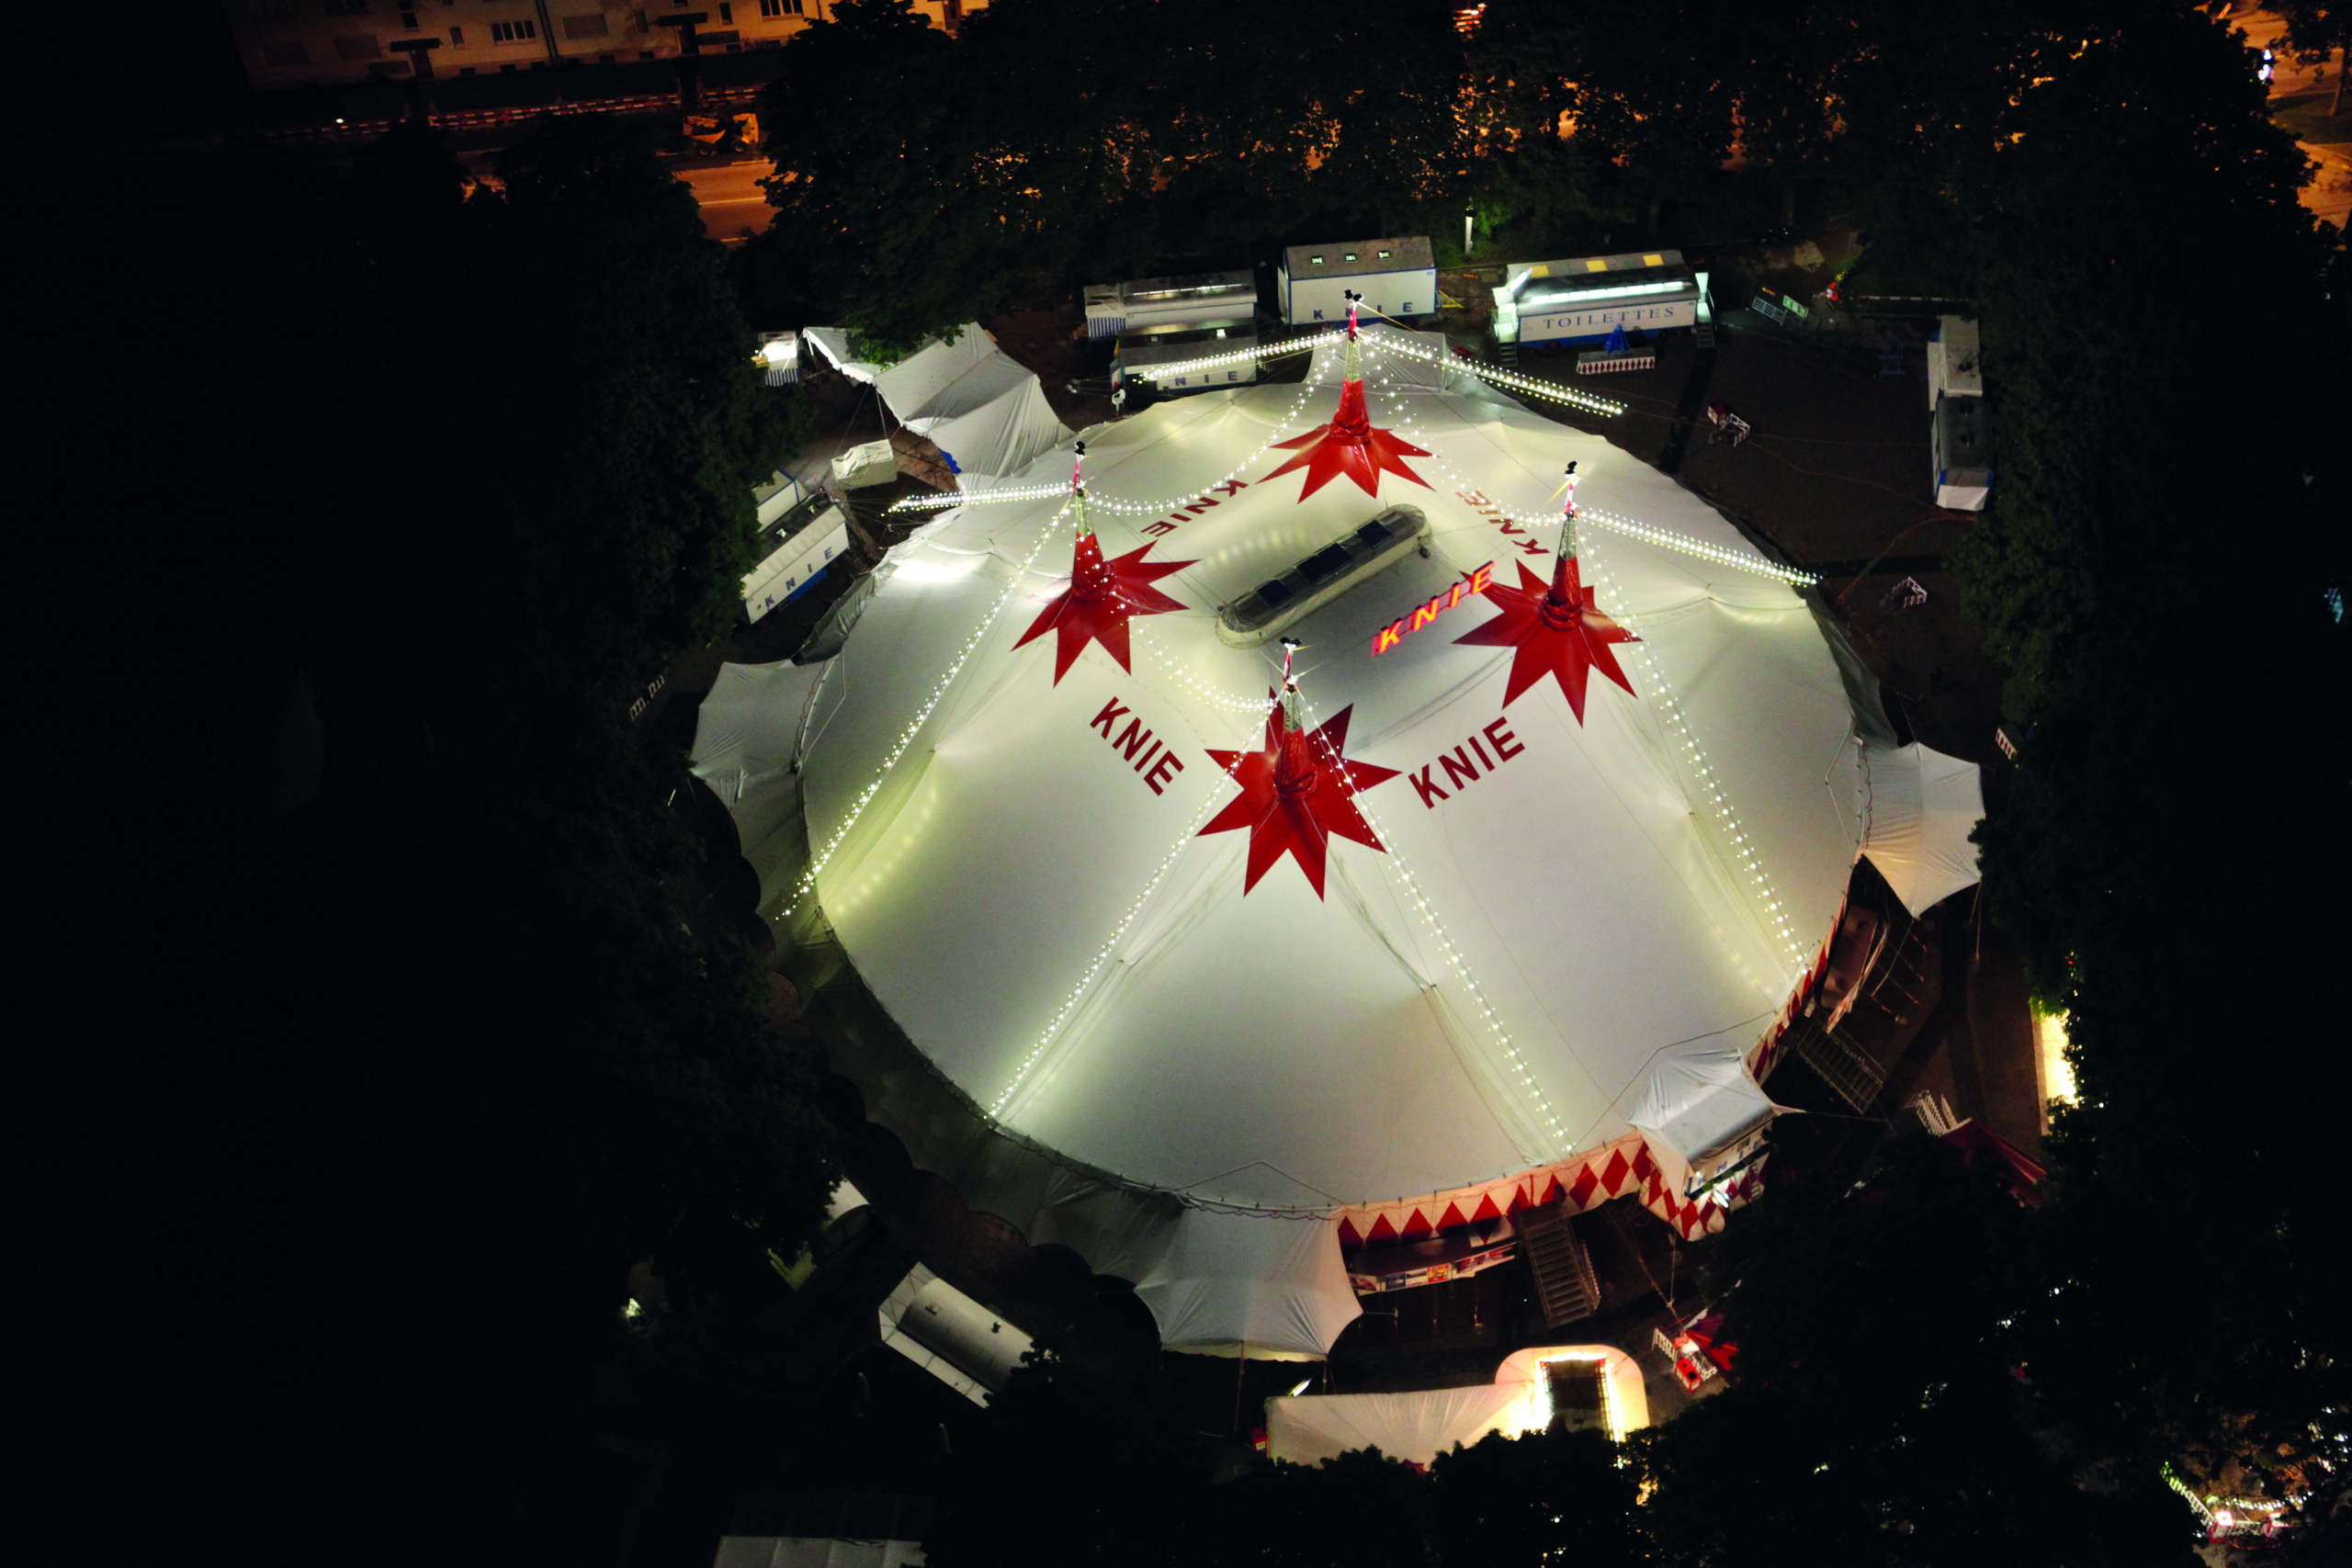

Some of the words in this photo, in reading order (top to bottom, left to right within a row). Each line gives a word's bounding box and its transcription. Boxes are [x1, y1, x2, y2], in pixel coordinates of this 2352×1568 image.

[1543, 307, 1675, 330] TOILETTES
[1174, 371, 1238, 386] NIE
[1140, 479, 1249, 537] KNIE
[1454, 490, 1551, 555] KNIE
[764, 547, 833, 608] KNIE
[1378, 559, 1496, 654] KNIE
[1090, 696, 1185, 796] KNIE
[1408, 716, 1525, 809] KNIE
